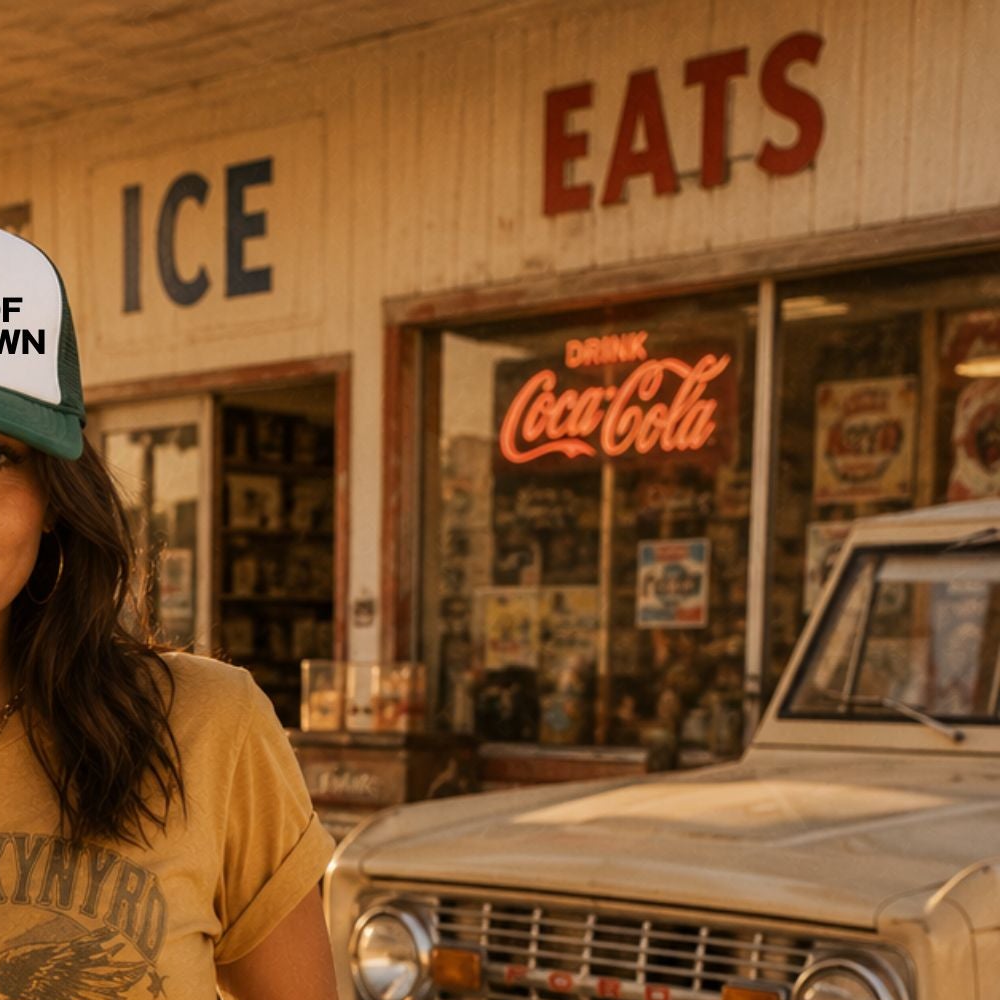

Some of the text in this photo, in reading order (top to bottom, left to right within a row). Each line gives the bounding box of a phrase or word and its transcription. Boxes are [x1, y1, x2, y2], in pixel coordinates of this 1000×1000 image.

[542, 30, 825, 217] EATS
[122, 155, 274, 315] ICE
[564, 330, 649, 368] DRINK
